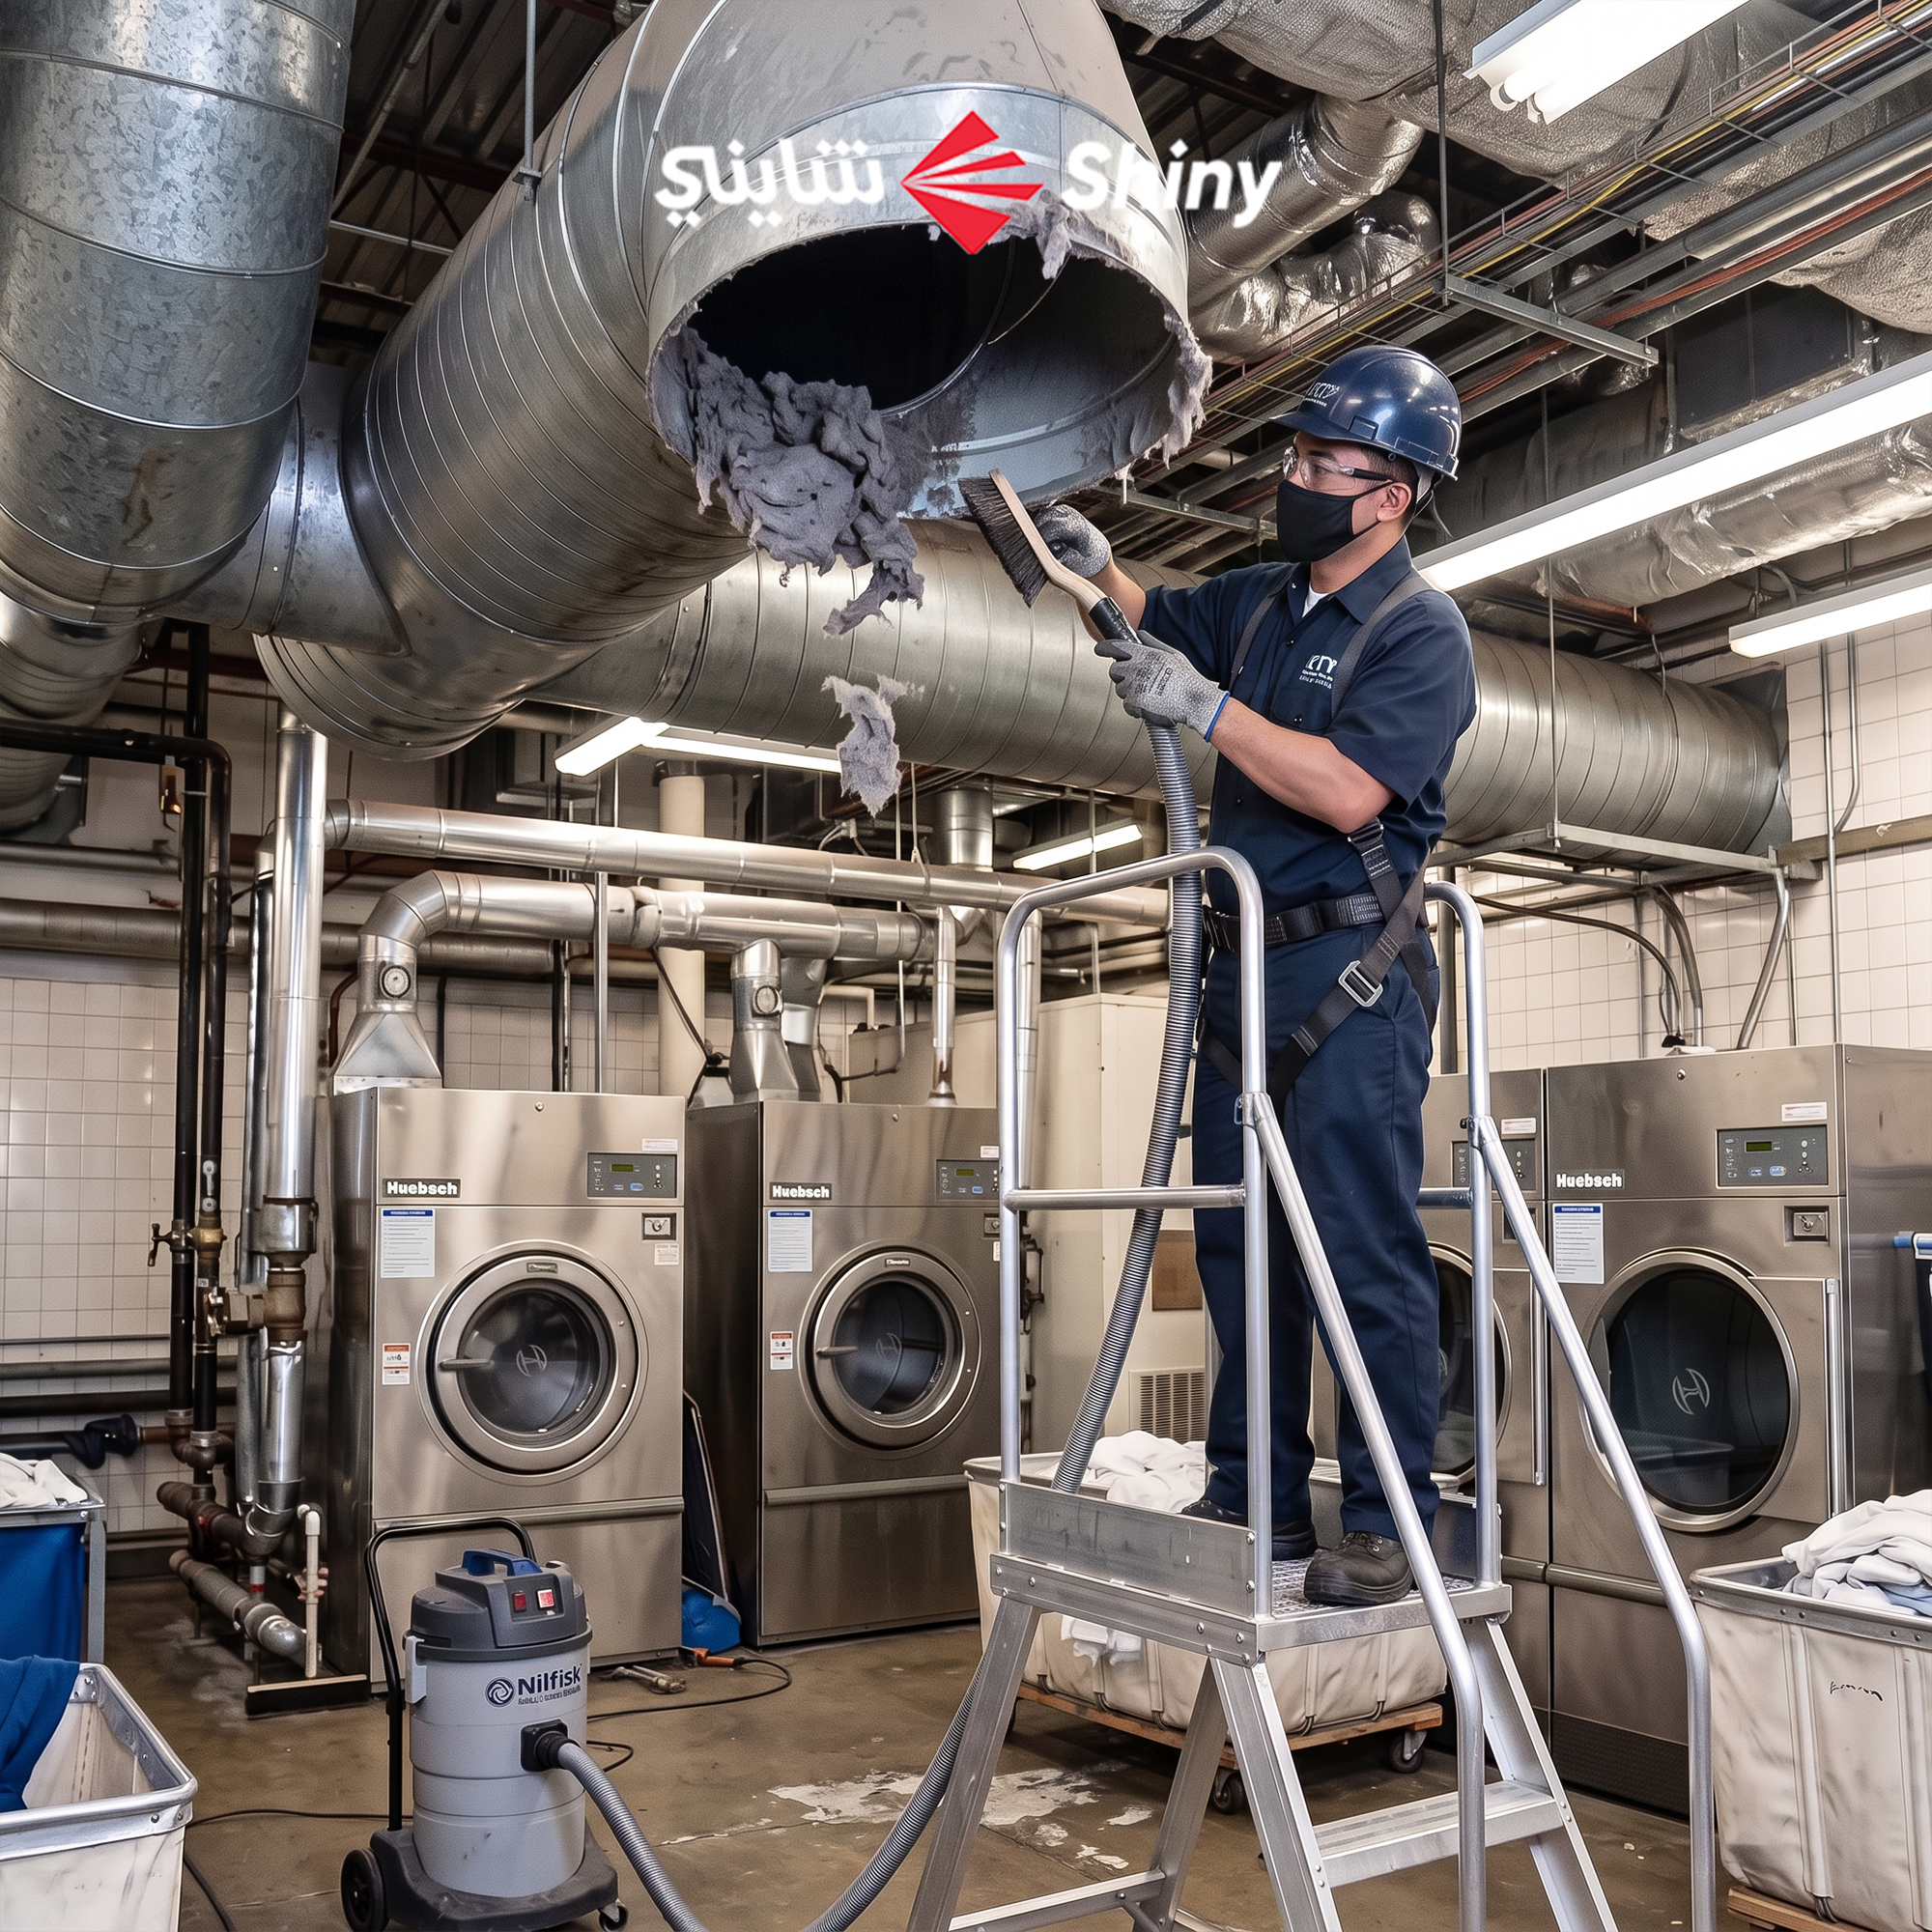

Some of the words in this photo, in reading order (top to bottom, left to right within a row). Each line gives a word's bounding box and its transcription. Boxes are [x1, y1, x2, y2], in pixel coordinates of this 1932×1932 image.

[386, 1180, 458, 1195] Huebsch
[772, 1184, 830, 1198] Huebsch
[517, 1665, 582, 1695] Nilfisk
